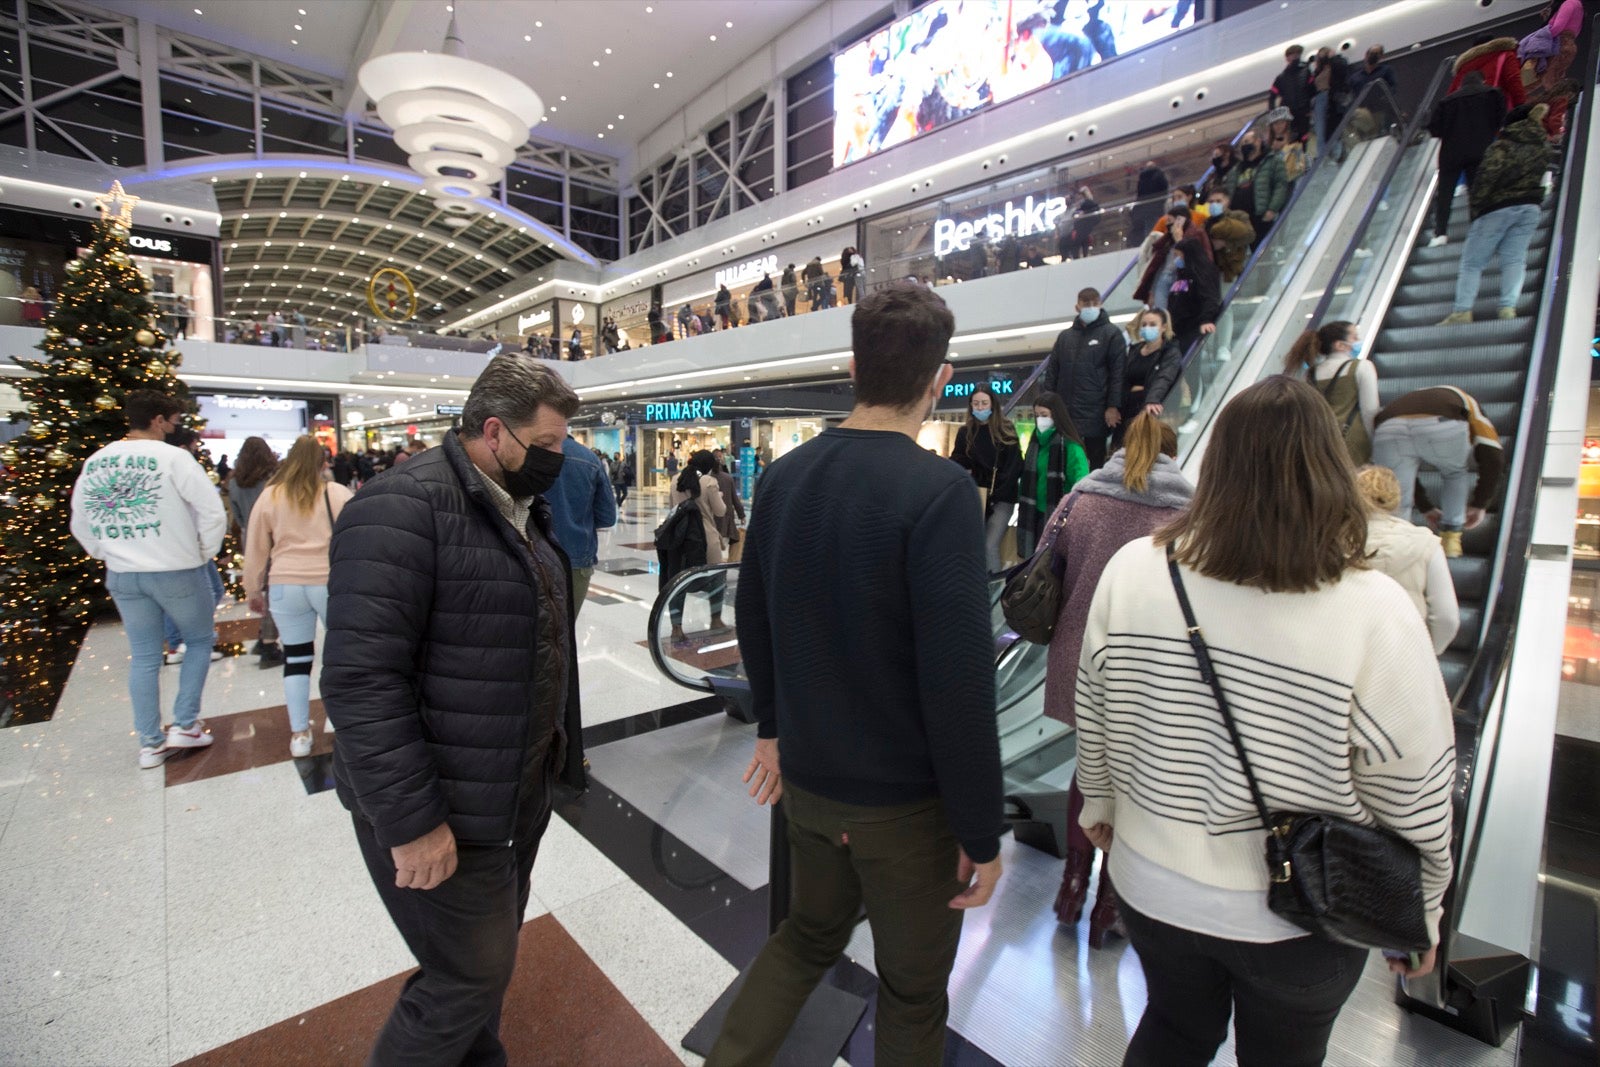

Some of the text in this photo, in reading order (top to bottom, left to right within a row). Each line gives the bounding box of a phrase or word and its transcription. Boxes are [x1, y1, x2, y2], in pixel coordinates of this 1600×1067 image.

[128, 236, 172, 251] OUS
[945, 380, 1013, 397] PRIRK
[646, 399, 714, 421] PRIMARK
[86, 454, 158, 475] RICK AND
[89, 519, 161, 540] MORTY
